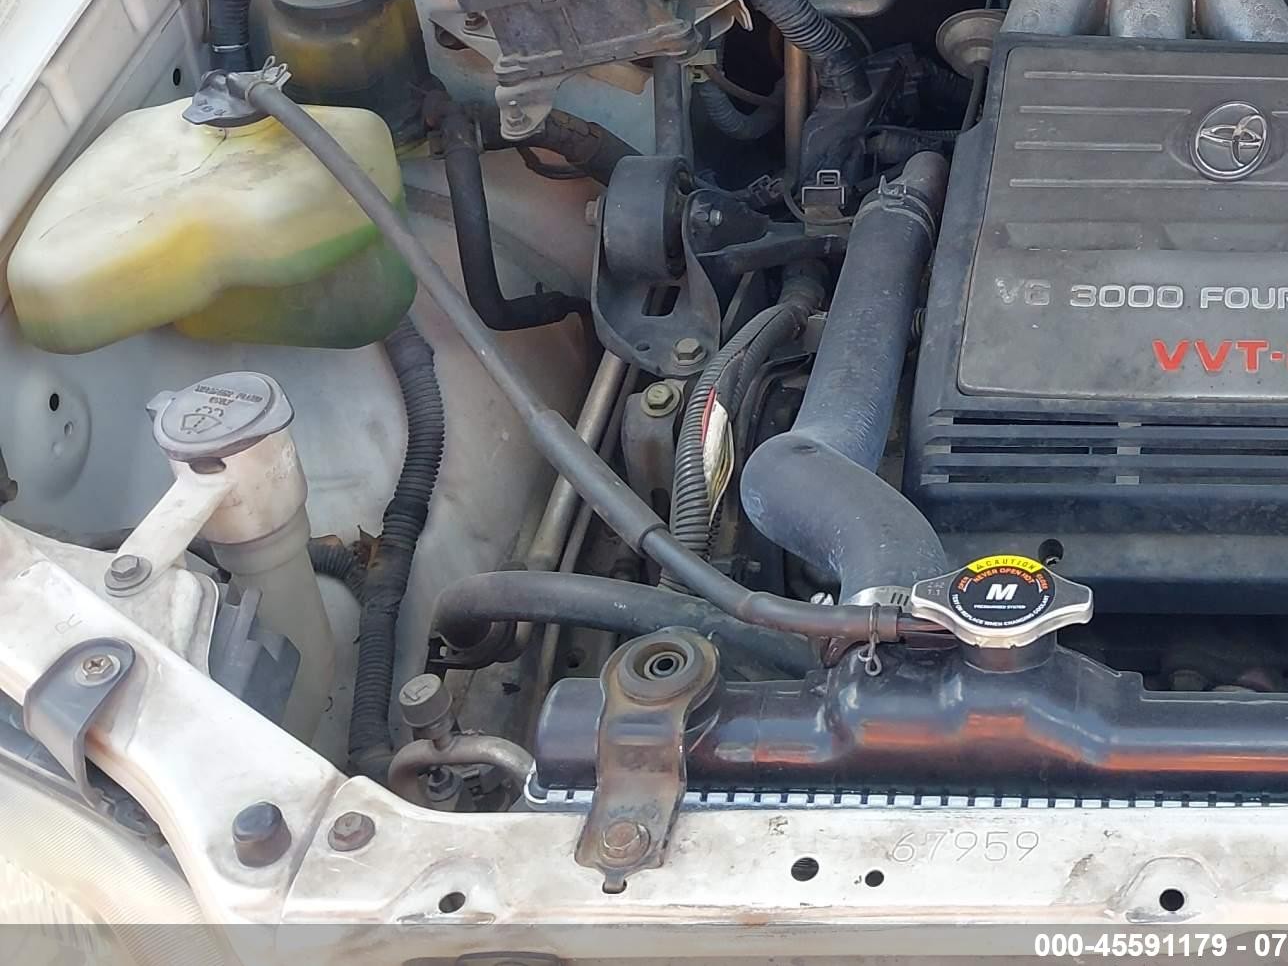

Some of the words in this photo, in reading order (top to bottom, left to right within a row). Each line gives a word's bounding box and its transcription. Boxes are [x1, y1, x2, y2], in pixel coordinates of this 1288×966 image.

[995, 280, 1052, 307] V6
[1069, 285, 1185, 309] 3000
[972, 569, 998, 583] NEVER
[999, 567, 1022, 576] OPEN
[986, 558, 1037, 570] CAUTION
[986, 583, 1018, 601] M
[960, 610, 983, 624] REPLACE
[1003, 613, 1035, 626] CHANGING
[1032, 595, 1050, 615] COOLANT
[892, 830, 1040, 863] 67959
